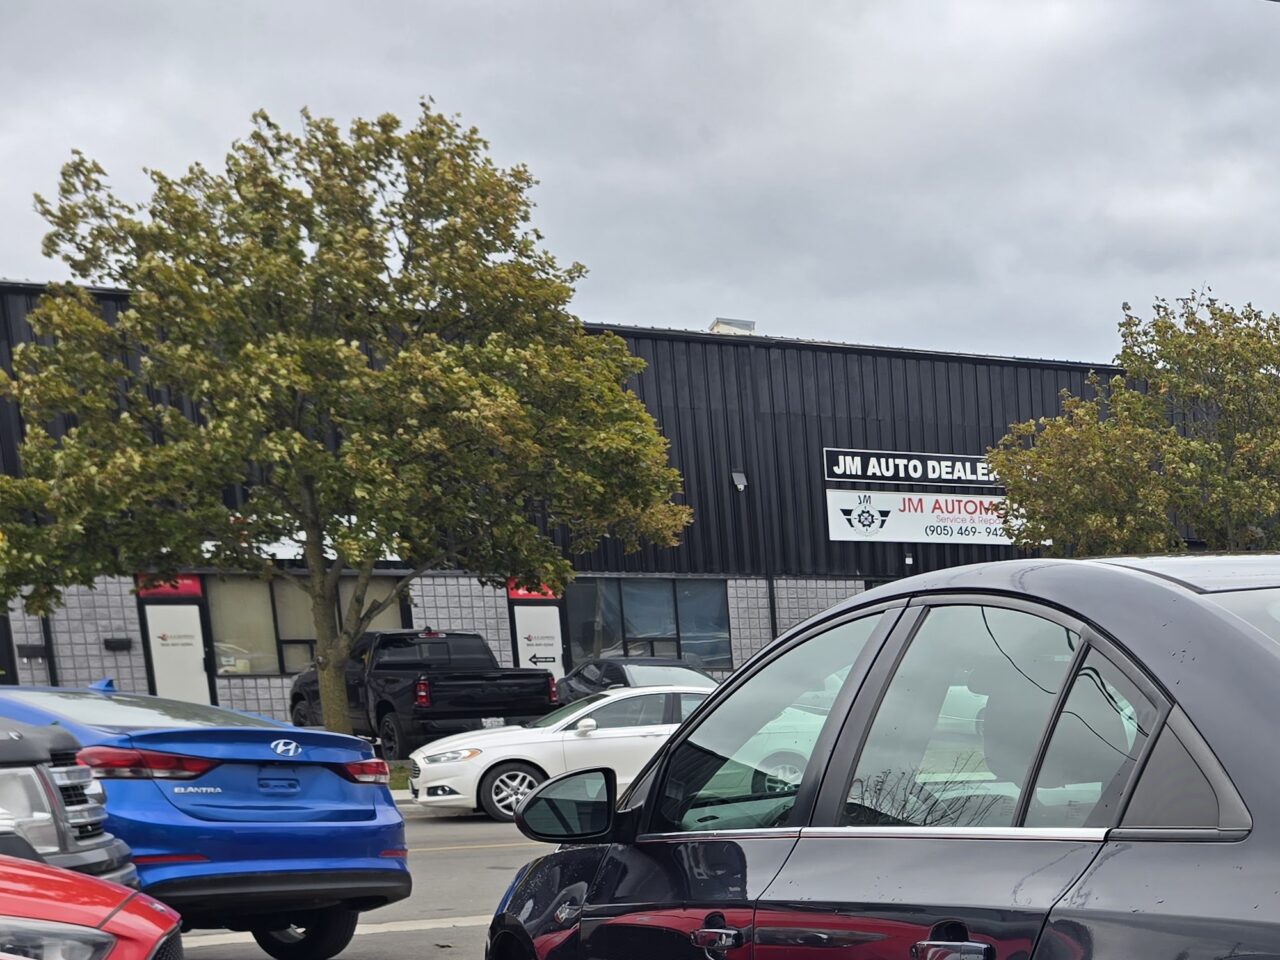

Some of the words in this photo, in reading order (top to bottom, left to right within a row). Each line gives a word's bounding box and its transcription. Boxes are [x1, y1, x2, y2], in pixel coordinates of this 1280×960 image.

[833, 455, 862, 475] JM
[866, 457, 923, 479] AUTO
[898, 497, 924, 513] JM
[936, 514, 967, 524] Service
[969, 515, 976, 524] &
[924, 524, 954, 537] (905)
[956, 525, 982, 537] 469-
